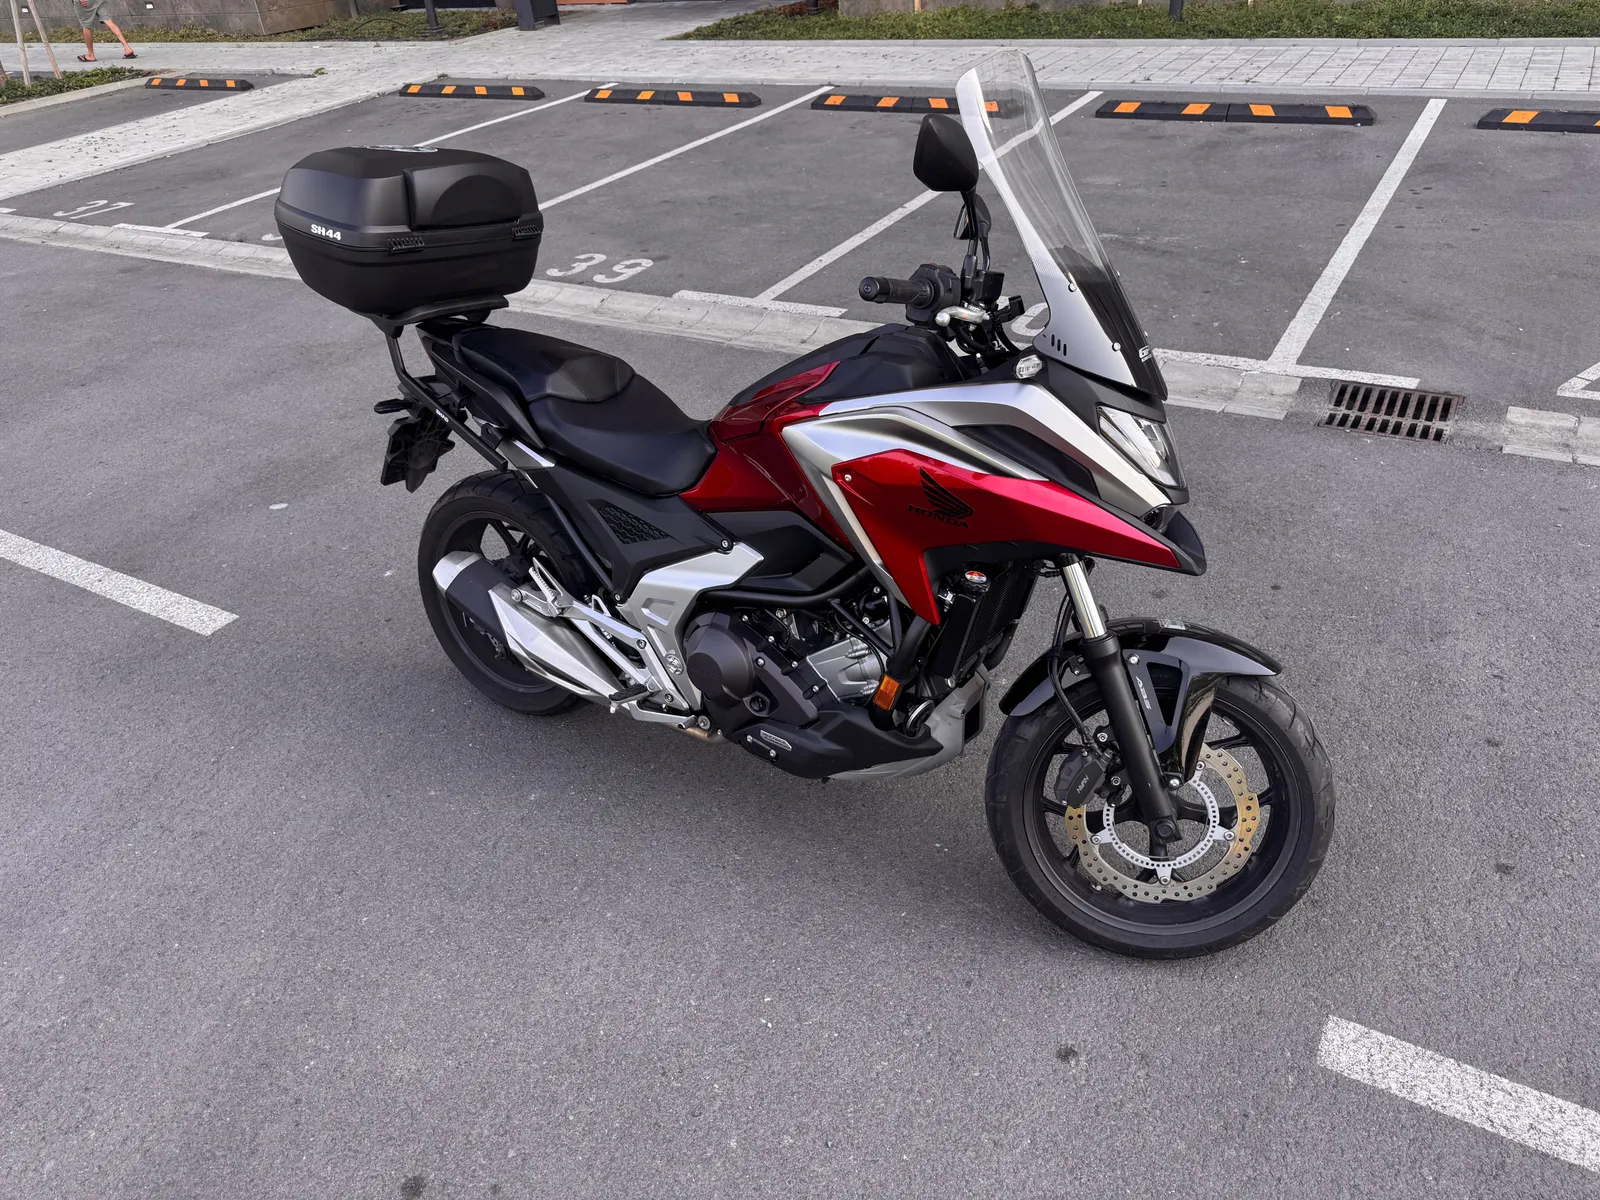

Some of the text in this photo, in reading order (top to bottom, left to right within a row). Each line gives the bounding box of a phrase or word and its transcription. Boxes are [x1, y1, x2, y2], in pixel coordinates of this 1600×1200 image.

[53, 200, 135, 219] 37
[310, 223, 342, 241] SH44
[545, 253, 654, 284] 39
[908, 504, 972, 530] HONDA
[1135, 675, 1152, 710] ABS
